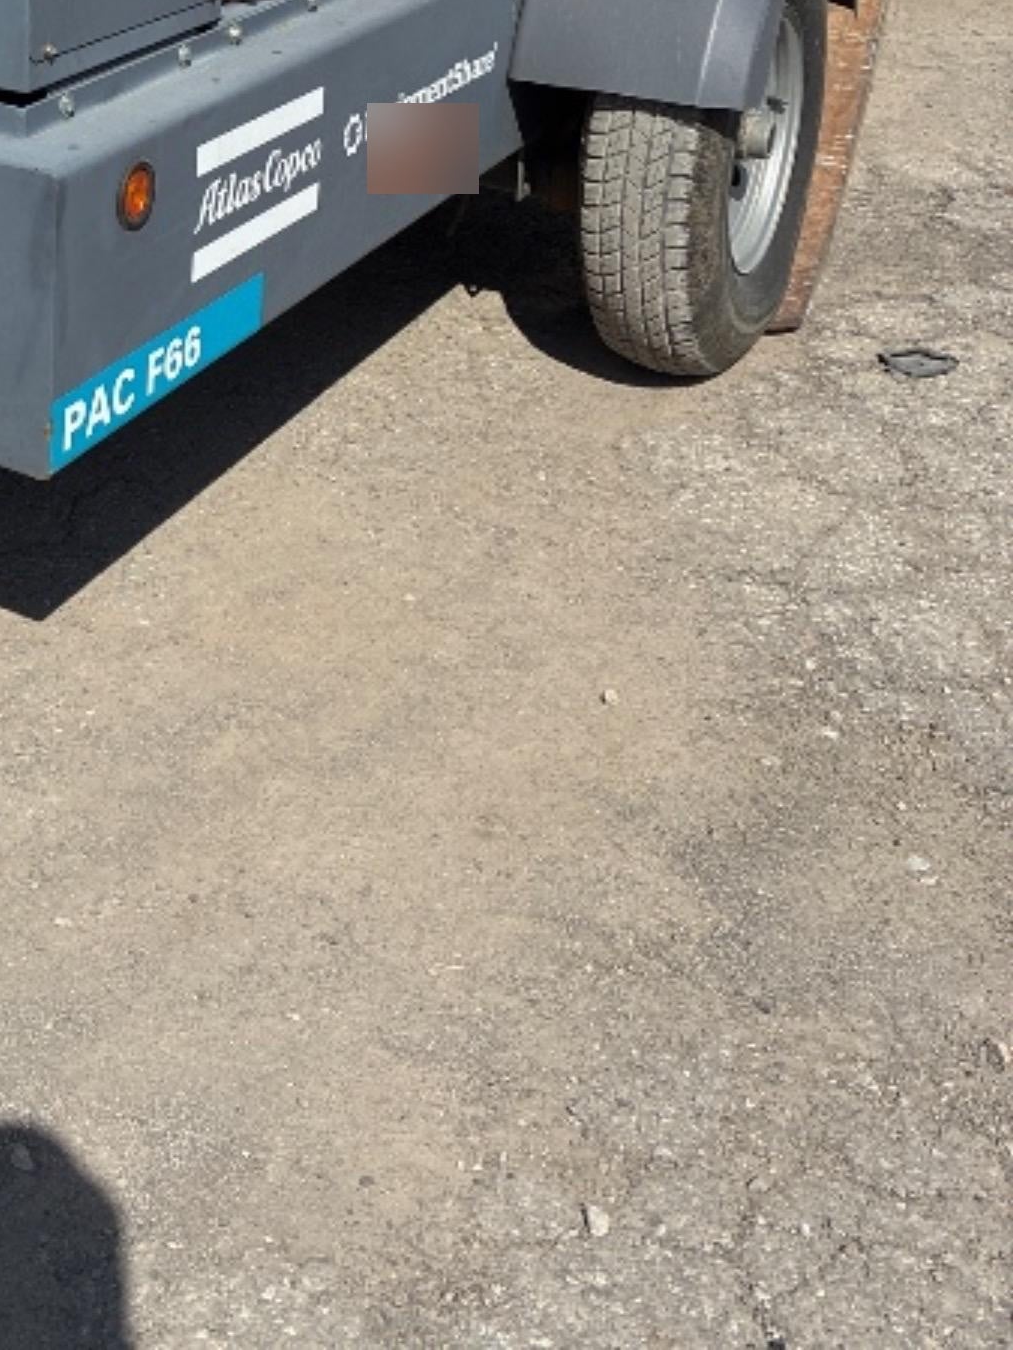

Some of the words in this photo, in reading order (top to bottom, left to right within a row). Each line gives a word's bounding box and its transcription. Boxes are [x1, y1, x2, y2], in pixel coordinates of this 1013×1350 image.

[193, 170, 261, 235] Atlas
[262, 137, 322, 193] Copco
[61, 368, 136, 452] PAC
[146, 324, 202, 396] F66
